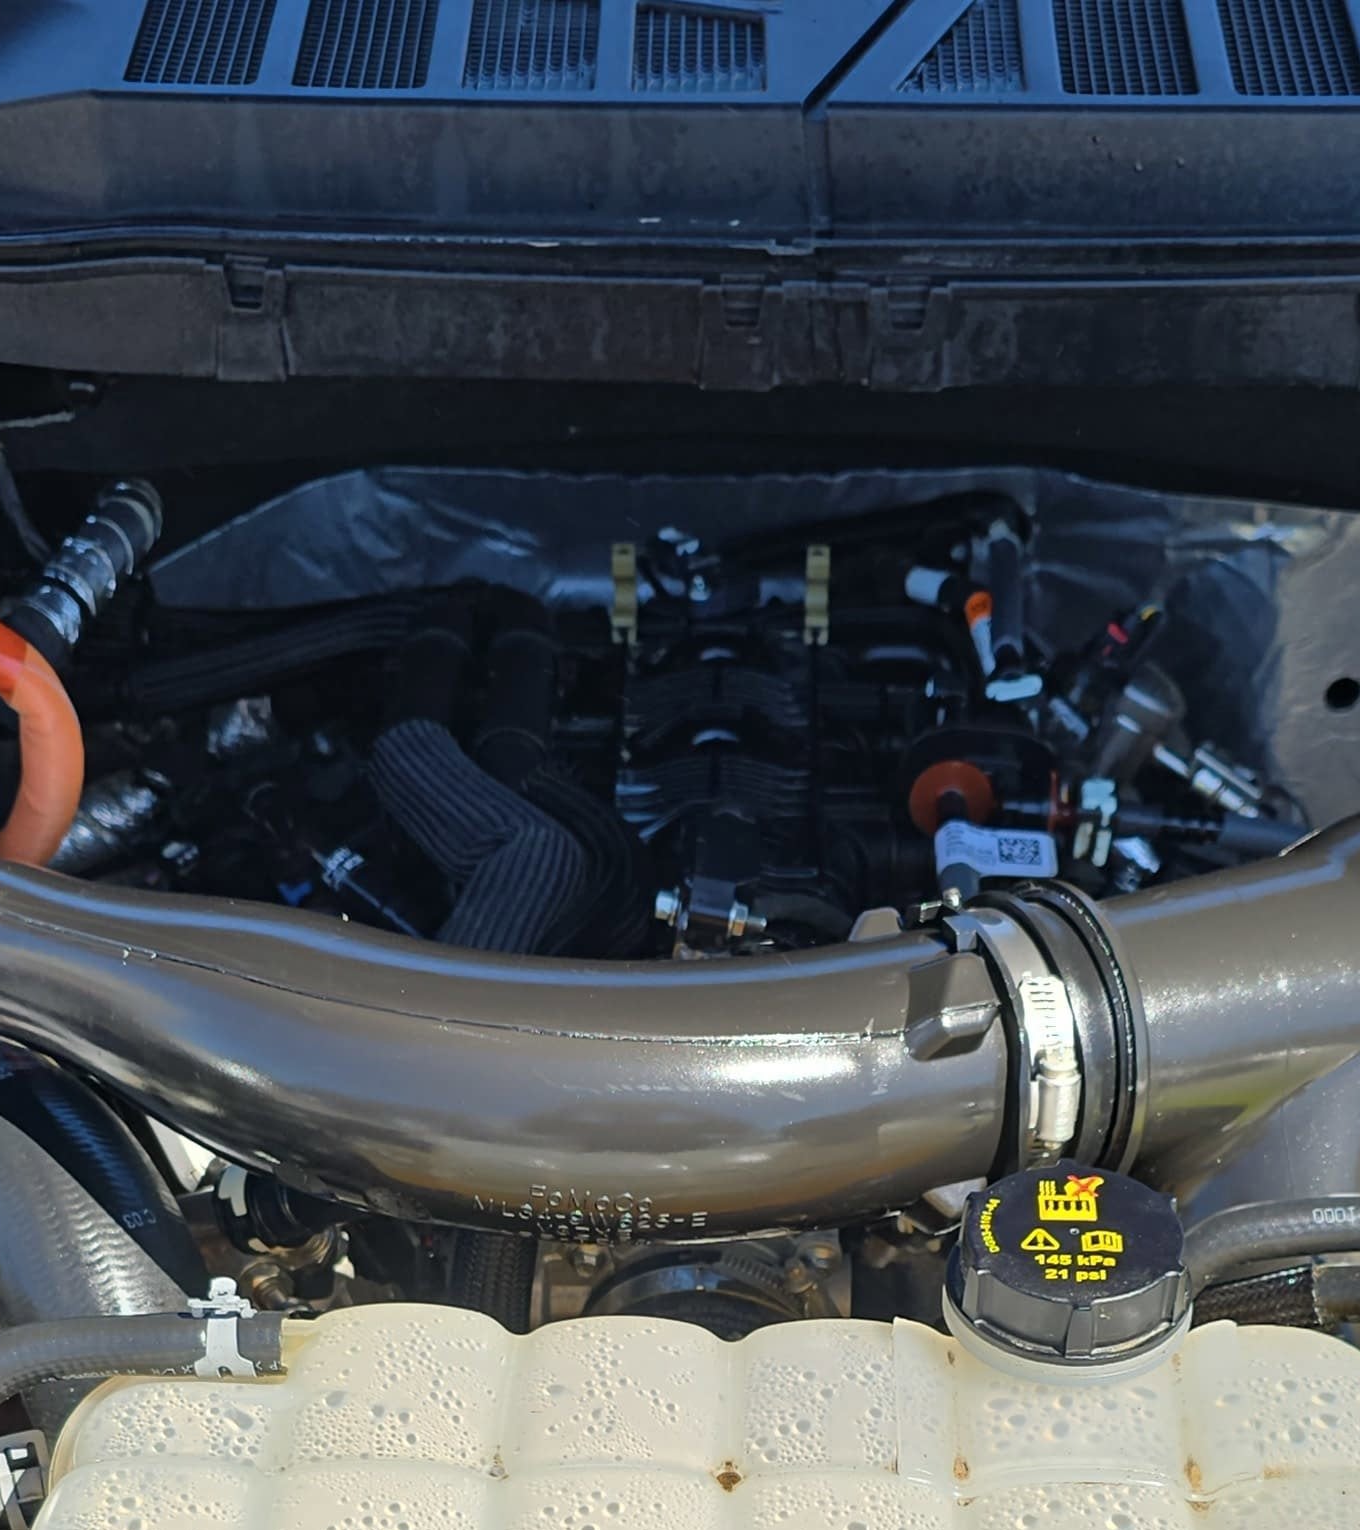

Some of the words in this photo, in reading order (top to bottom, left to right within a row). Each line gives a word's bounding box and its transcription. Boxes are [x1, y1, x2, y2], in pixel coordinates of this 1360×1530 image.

[1034, 1253, 1072, 1266] 145
[1076, 1254, 1117, 1268] kPa
[1044, 1268, 1069, 1280] 21
[1075, 1268, 1108, 1283] psi
